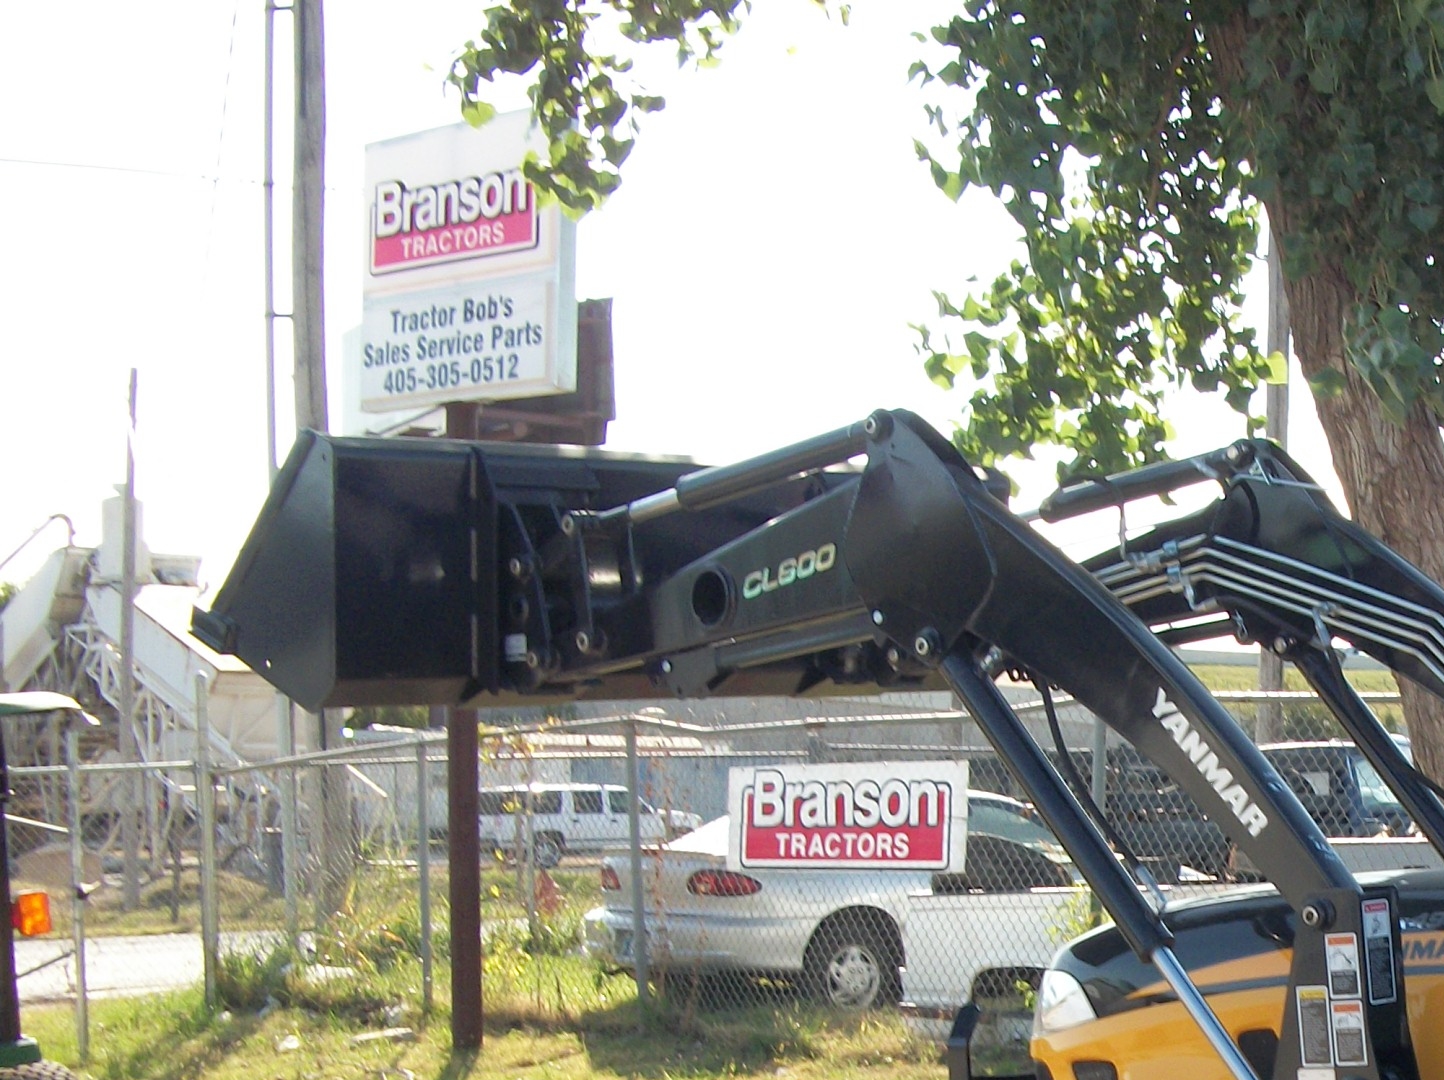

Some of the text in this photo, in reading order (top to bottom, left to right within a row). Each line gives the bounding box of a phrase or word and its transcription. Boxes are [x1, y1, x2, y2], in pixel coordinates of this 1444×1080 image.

[375, 167, 529, 238] Branson
[401, 221, 505, 260] TRACTORS
[390, 296, 513, 334] Tractor Bob's
[364, 322, 542, 369] Sales Service Parts
[384, 354, 519, 394] 405-305-0512
[743, 542, 836, 599] CL600
[1151, 686, 1268, 838] YANMAR
[753, 770, 939, 828] Branson
[775, 832, 909, 859] TRACTORS
